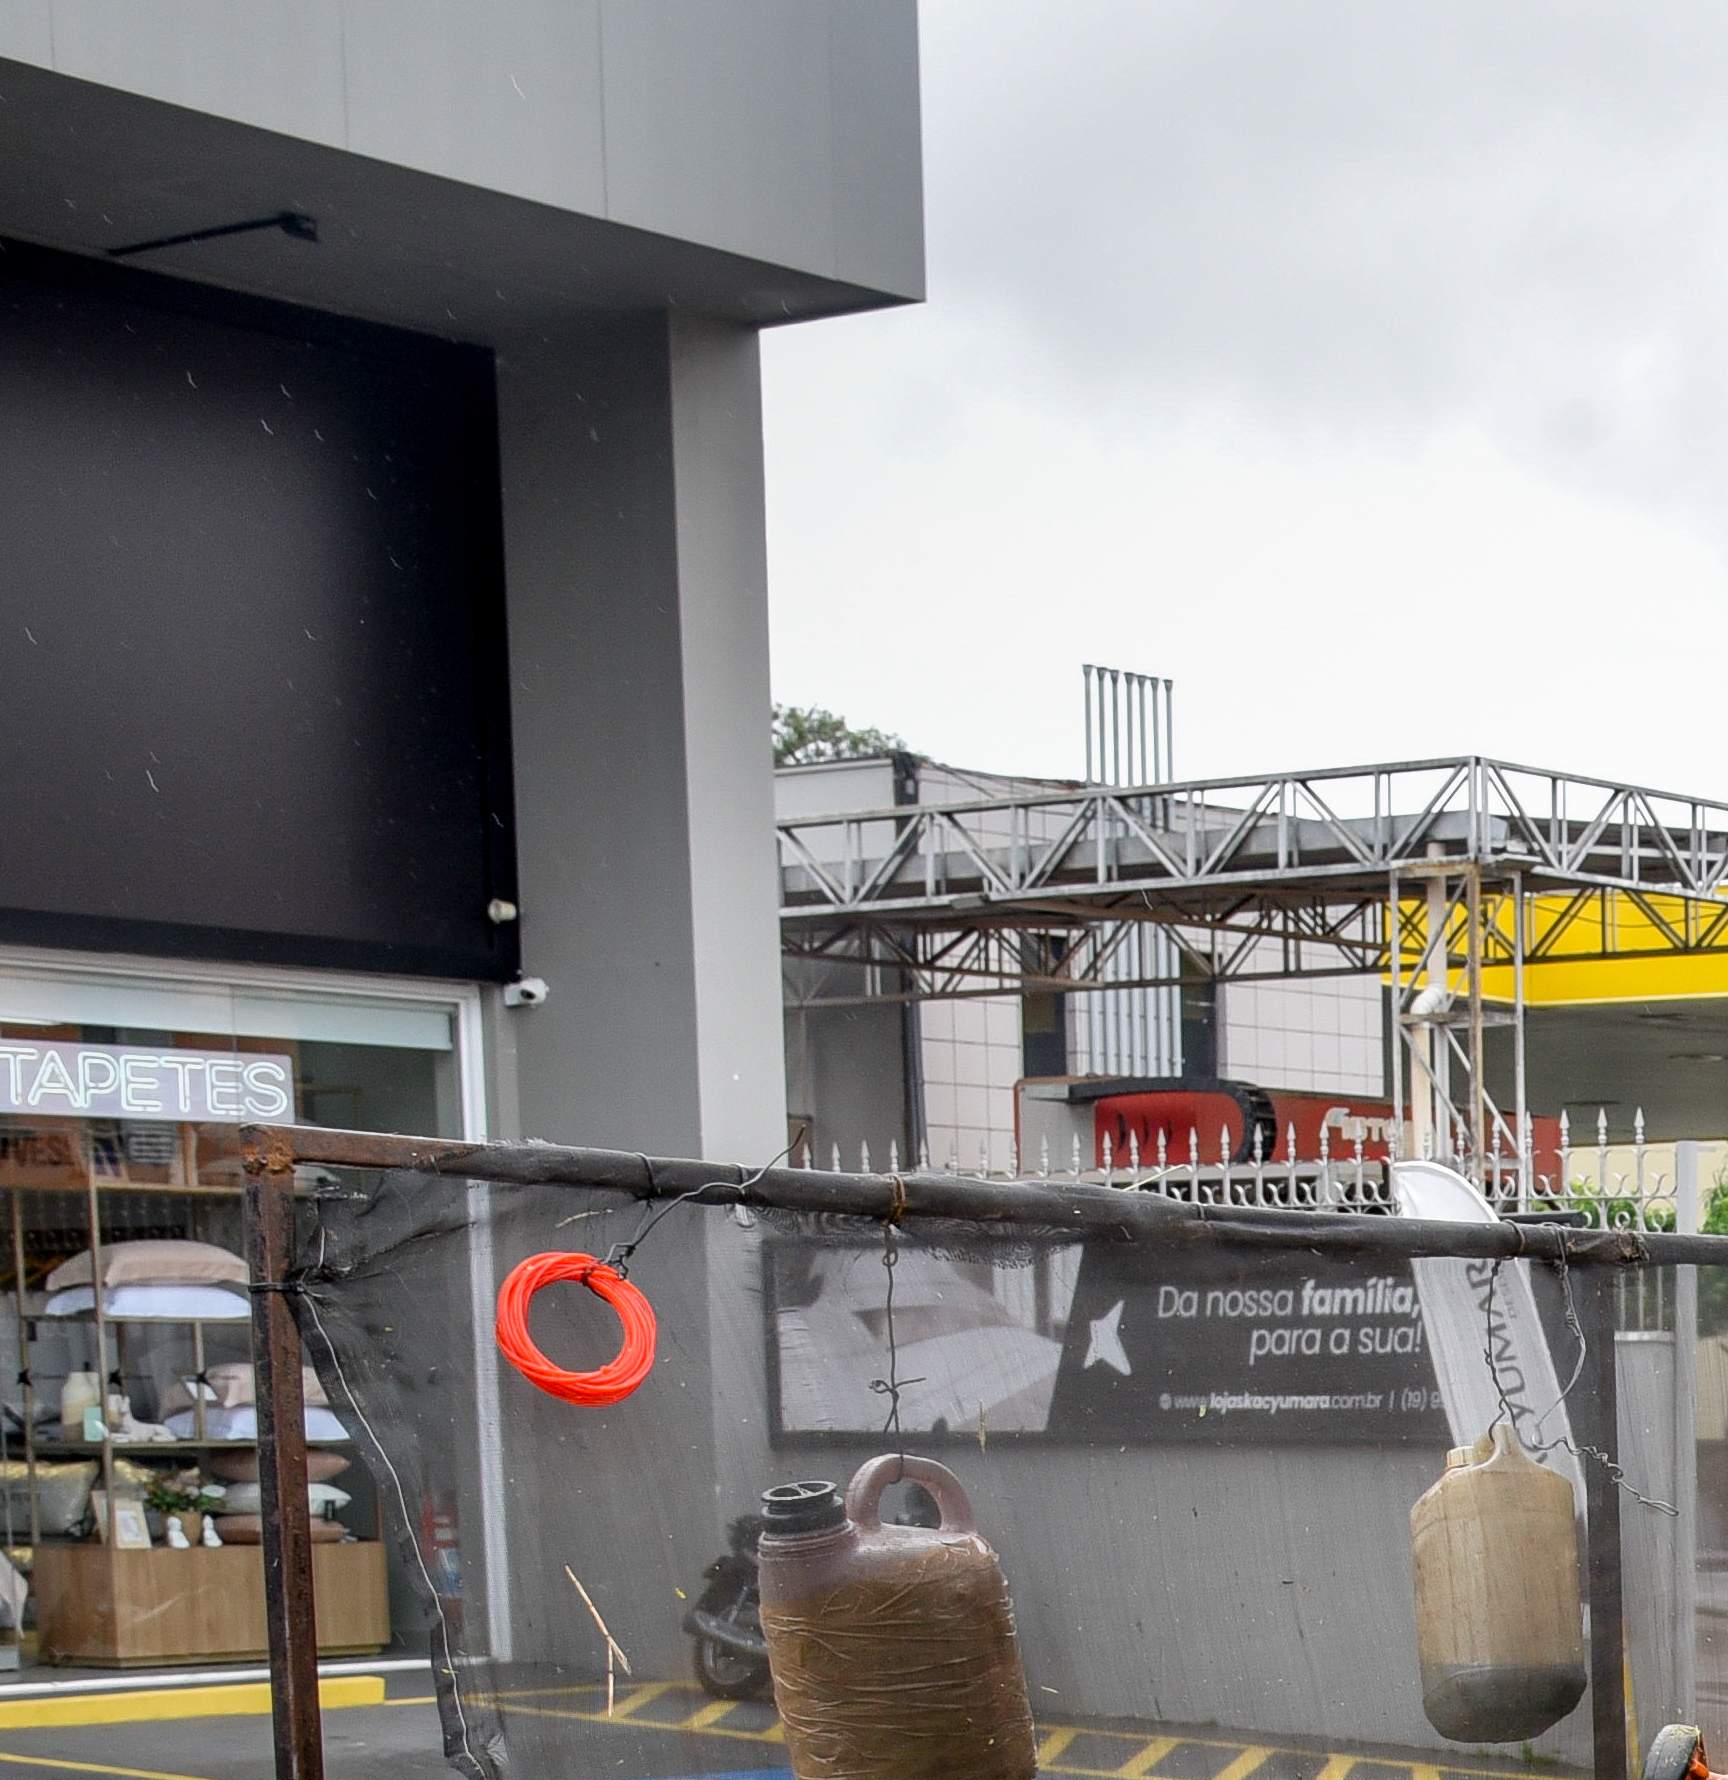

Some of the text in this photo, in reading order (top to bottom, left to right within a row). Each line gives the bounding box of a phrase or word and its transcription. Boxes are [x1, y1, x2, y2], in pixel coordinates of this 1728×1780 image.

[0, 1046, 289, 1118] TAPETES
[1158, 1276, 1422, 1318] Da nossa família,
[1249, 1321, 1423, 1366] para a sua!
